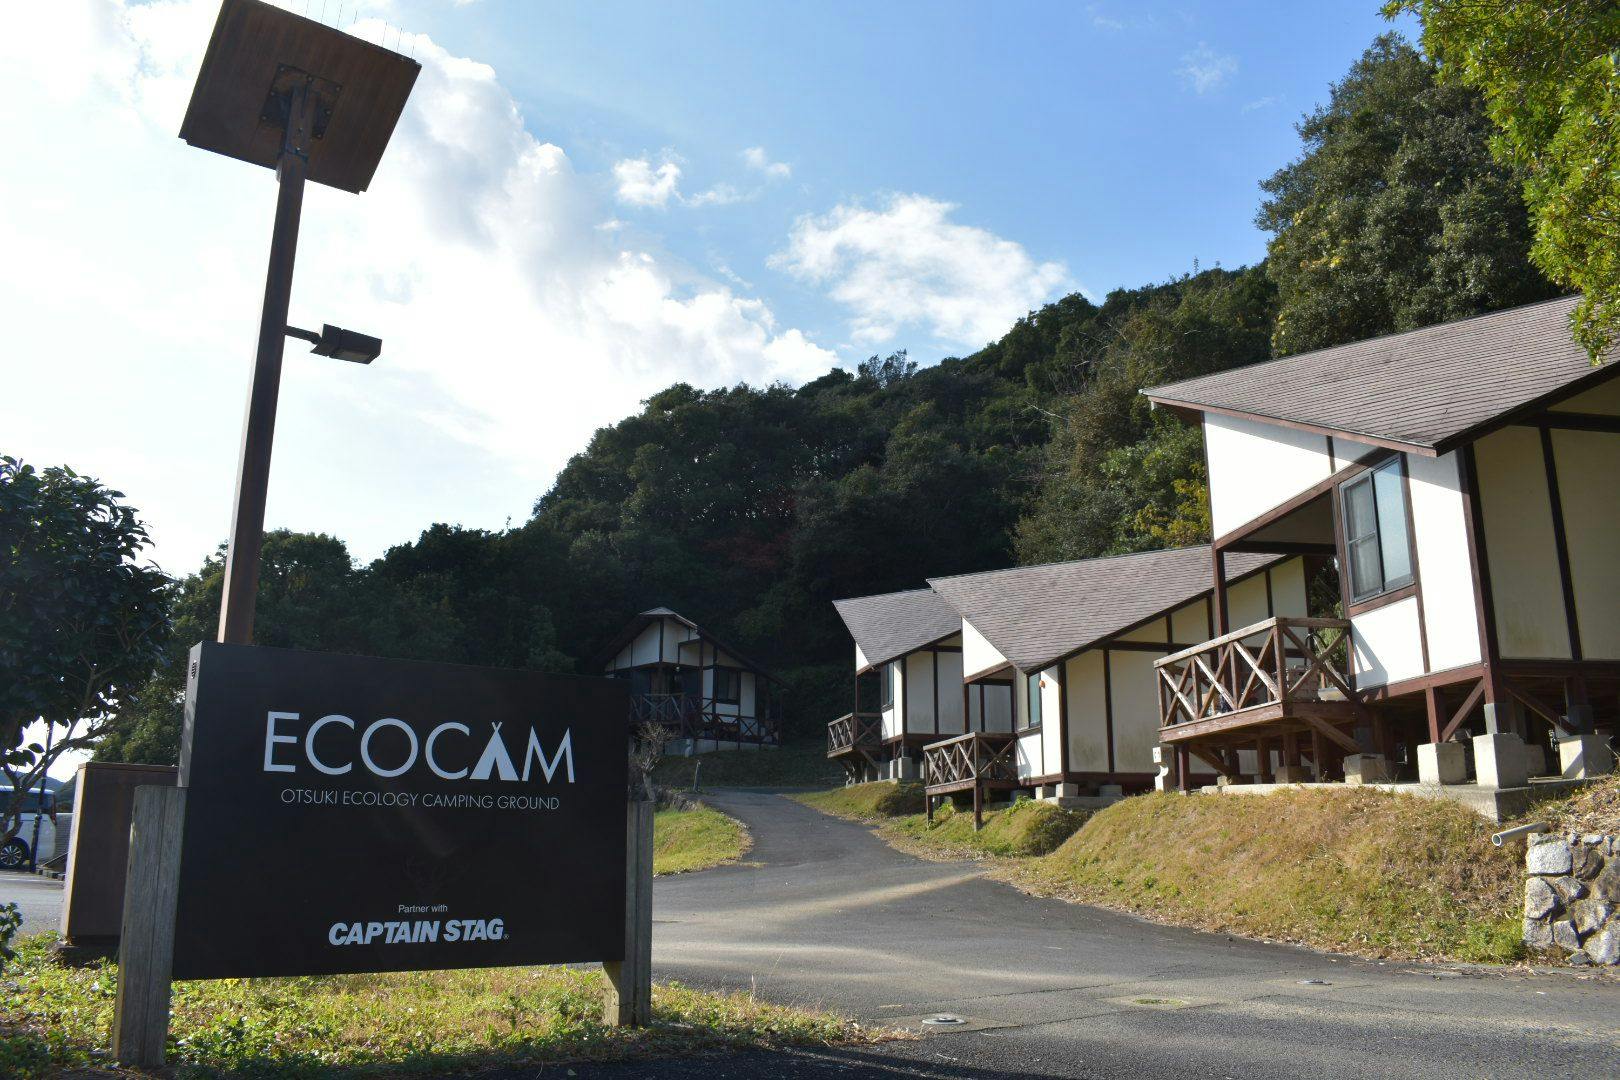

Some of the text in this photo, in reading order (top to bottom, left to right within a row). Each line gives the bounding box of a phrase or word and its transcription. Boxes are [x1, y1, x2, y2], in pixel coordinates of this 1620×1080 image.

[263, 711, 575, 784] ECOCAM
[280, 788, 560, 811] OTSUKI ECOLOGY CAMPING GROUND
[398, 903, 448, 914] Partner with
[328, 918, 504, 946] CAPTAIN STAG
